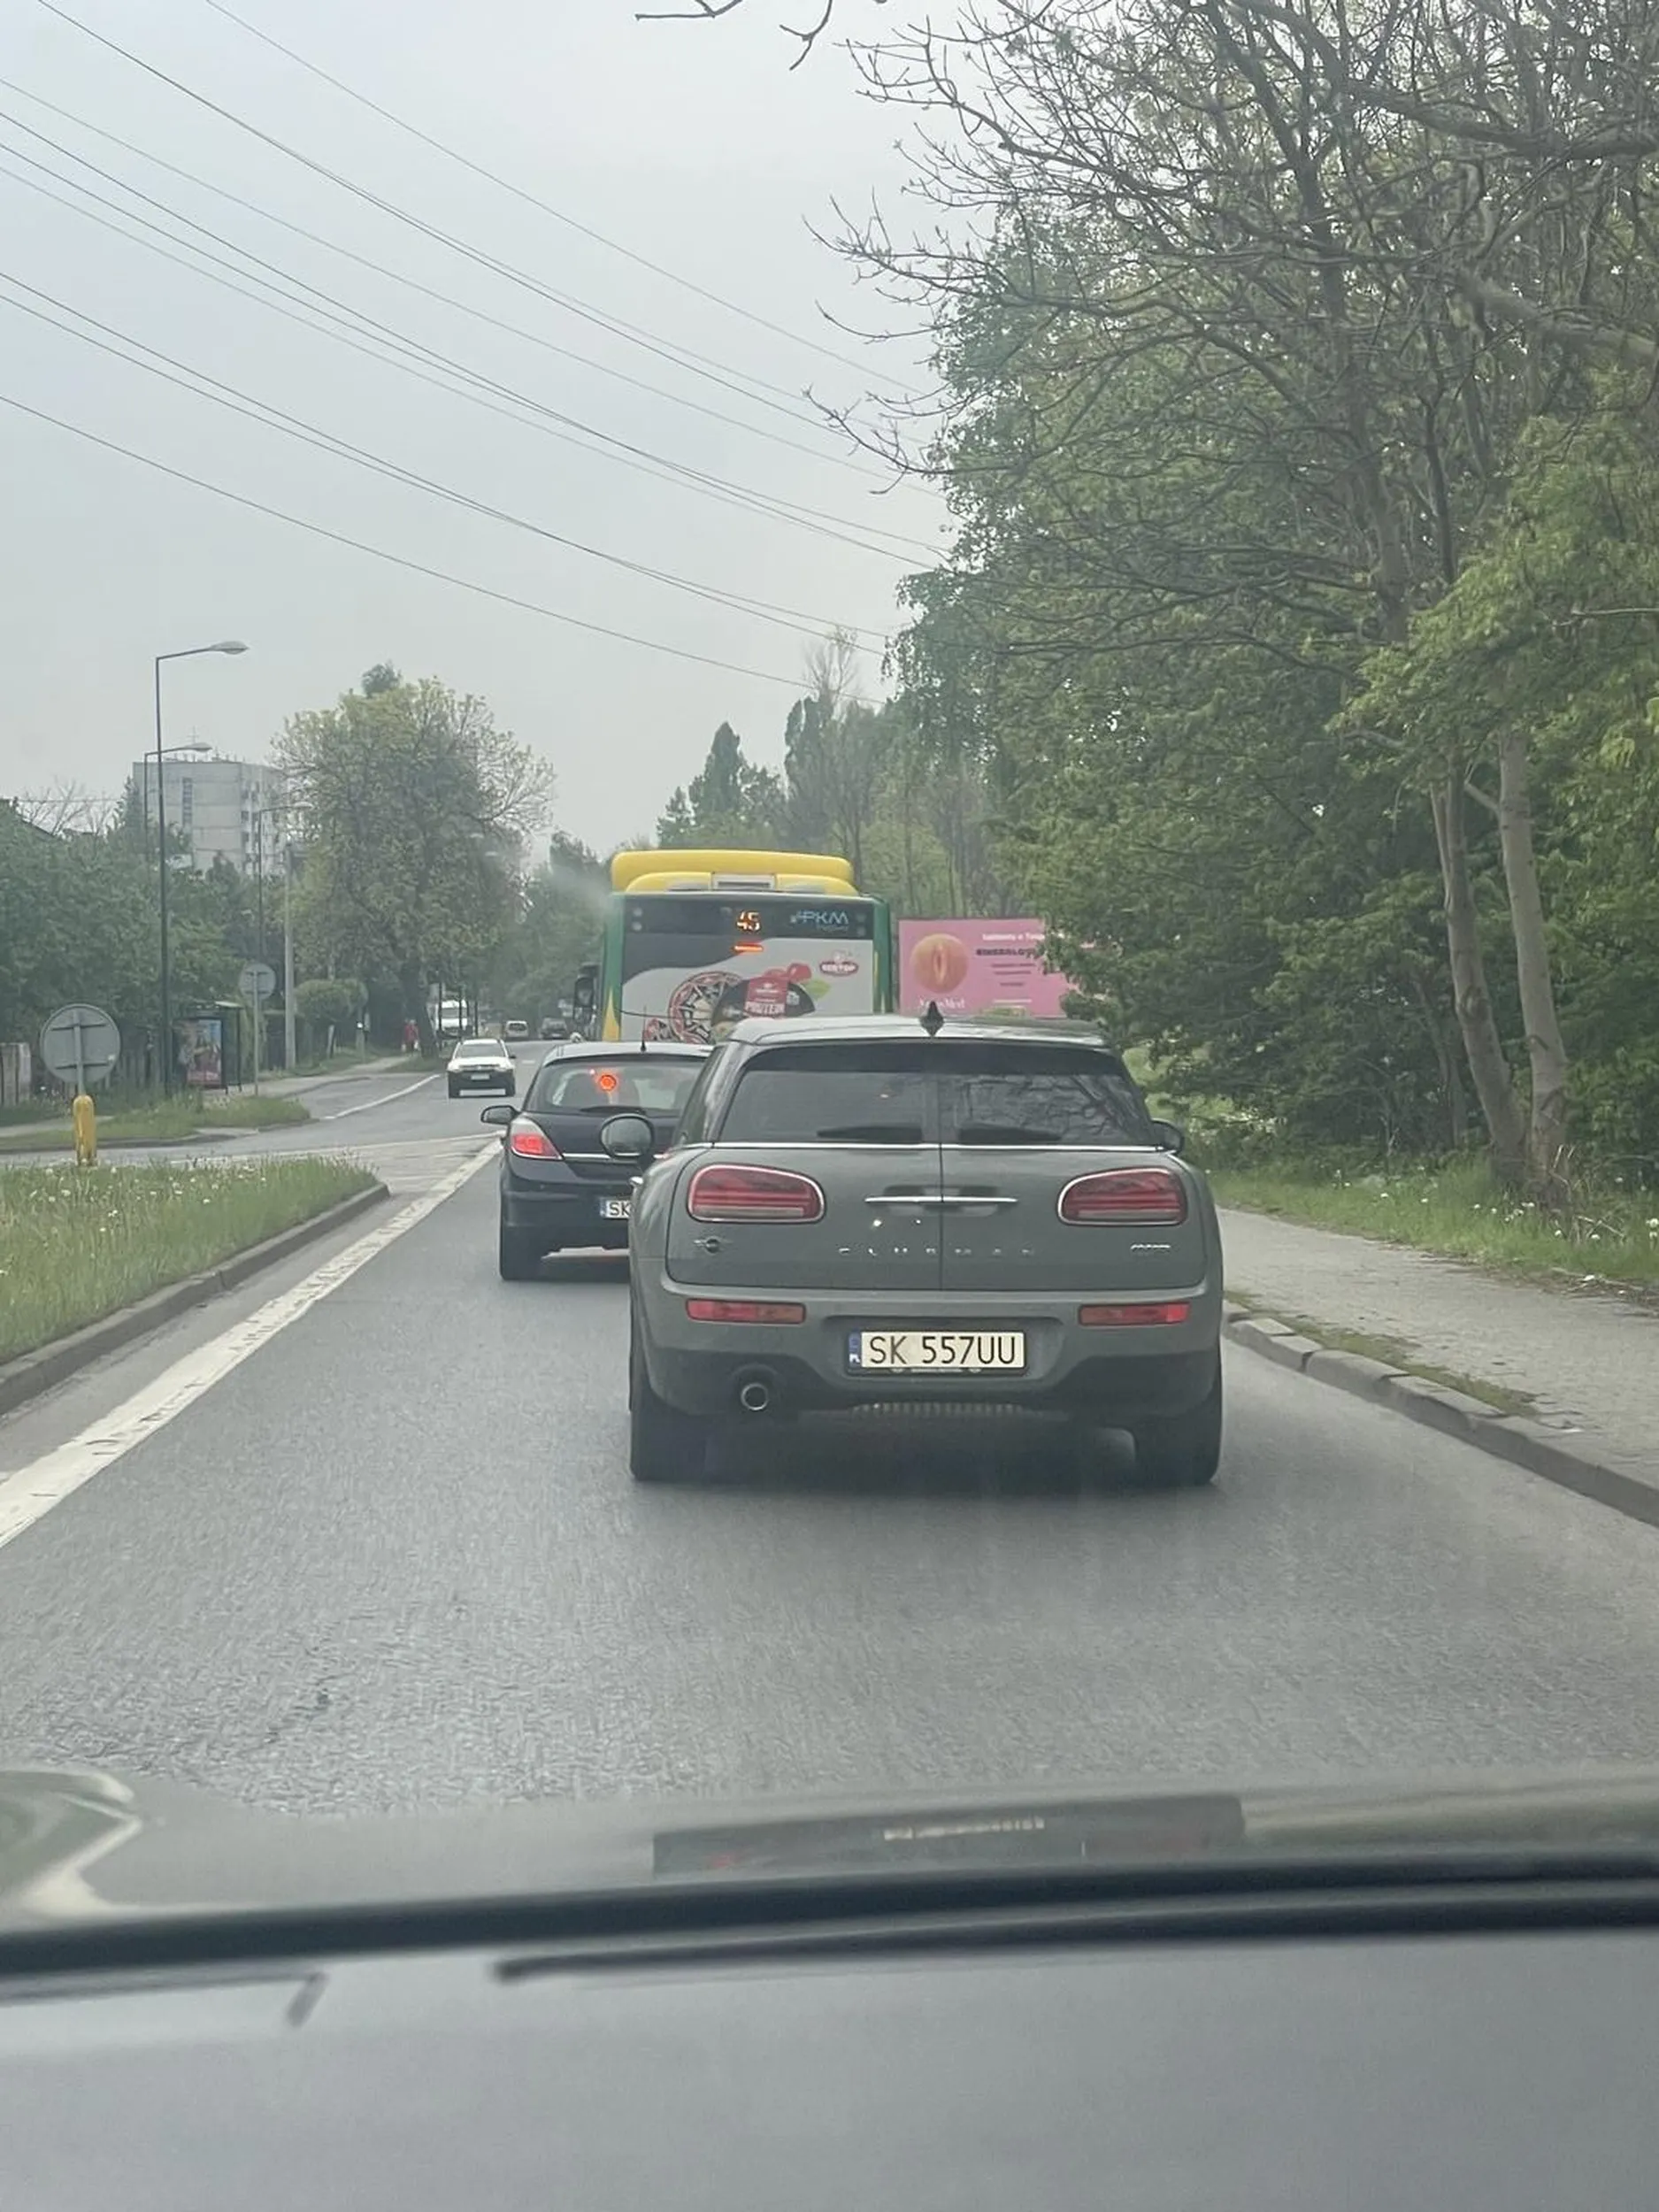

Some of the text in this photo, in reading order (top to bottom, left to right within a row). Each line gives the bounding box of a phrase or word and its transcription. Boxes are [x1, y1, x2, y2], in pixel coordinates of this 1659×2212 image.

[736, 910, 761, 931] 45
[870, 1336, 1016, 1364] SK 557UU
